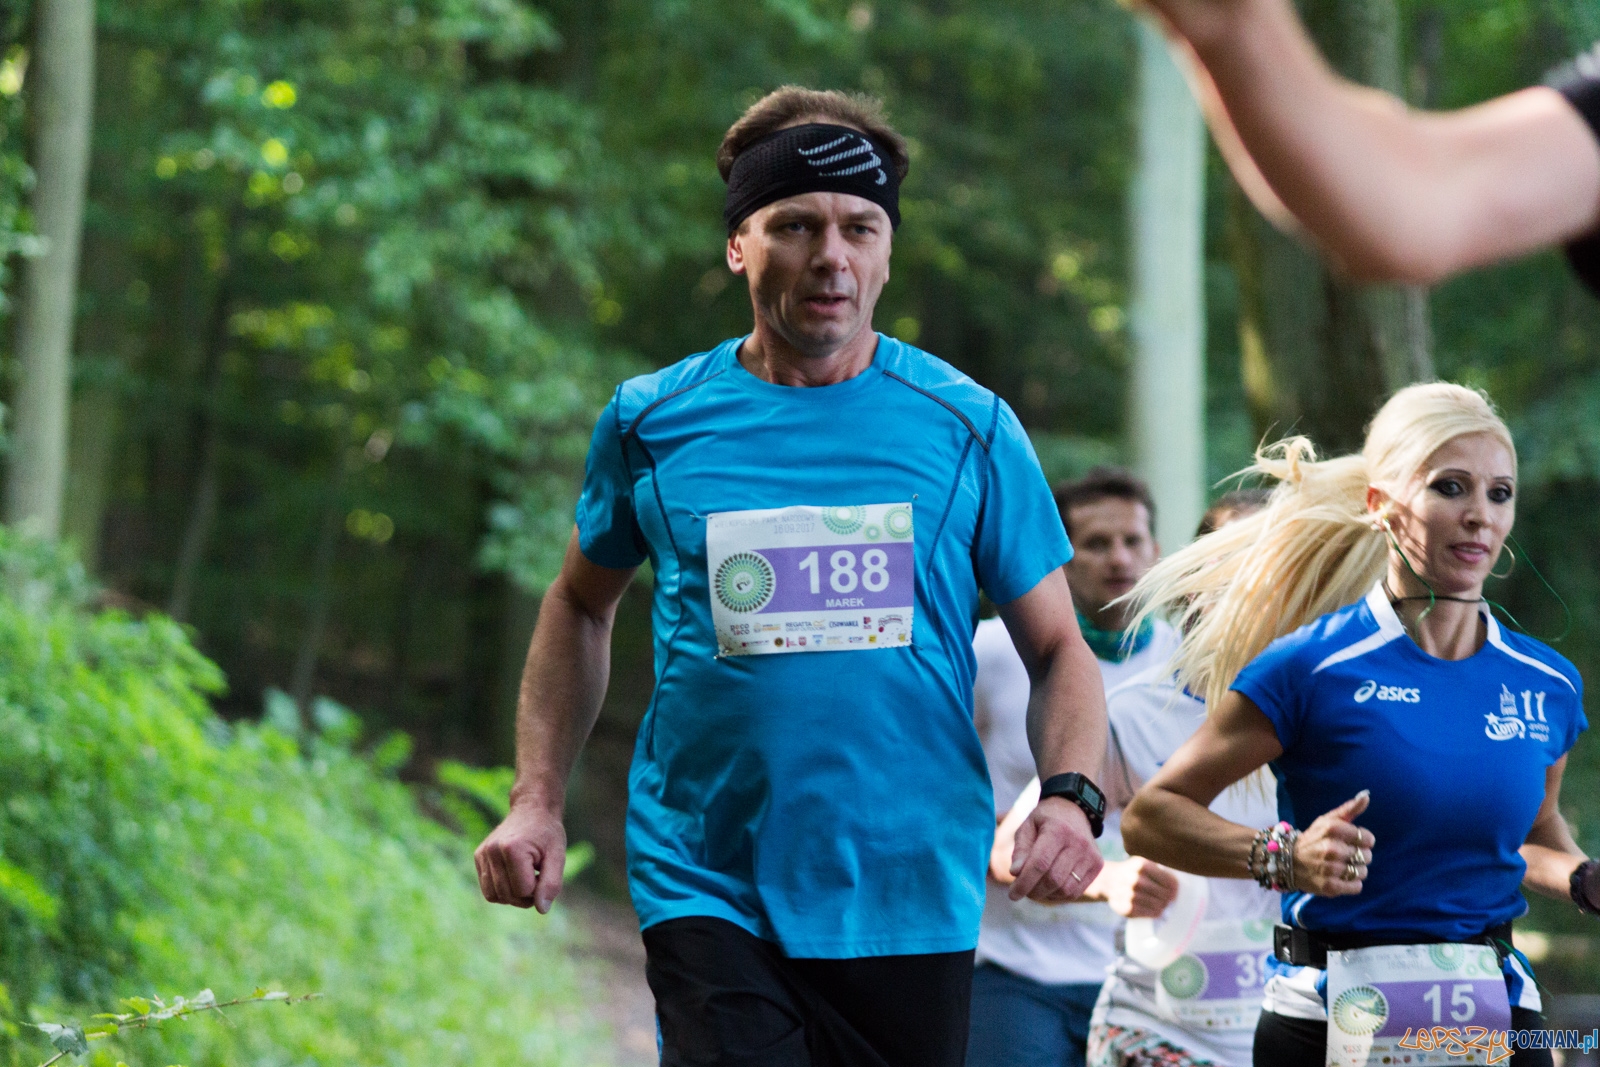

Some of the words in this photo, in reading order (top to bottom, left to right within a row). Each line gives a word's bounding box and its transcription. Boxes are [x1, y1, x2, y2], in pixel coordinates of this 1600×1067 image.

[799, 549, 890, 594] 188
[825, 598, 865, 608] MAREK
[1376, 685, 1421, 703] asics
[1520, 689, 1547, 723] 11
[1423, 984, 1477, 1024] 15
